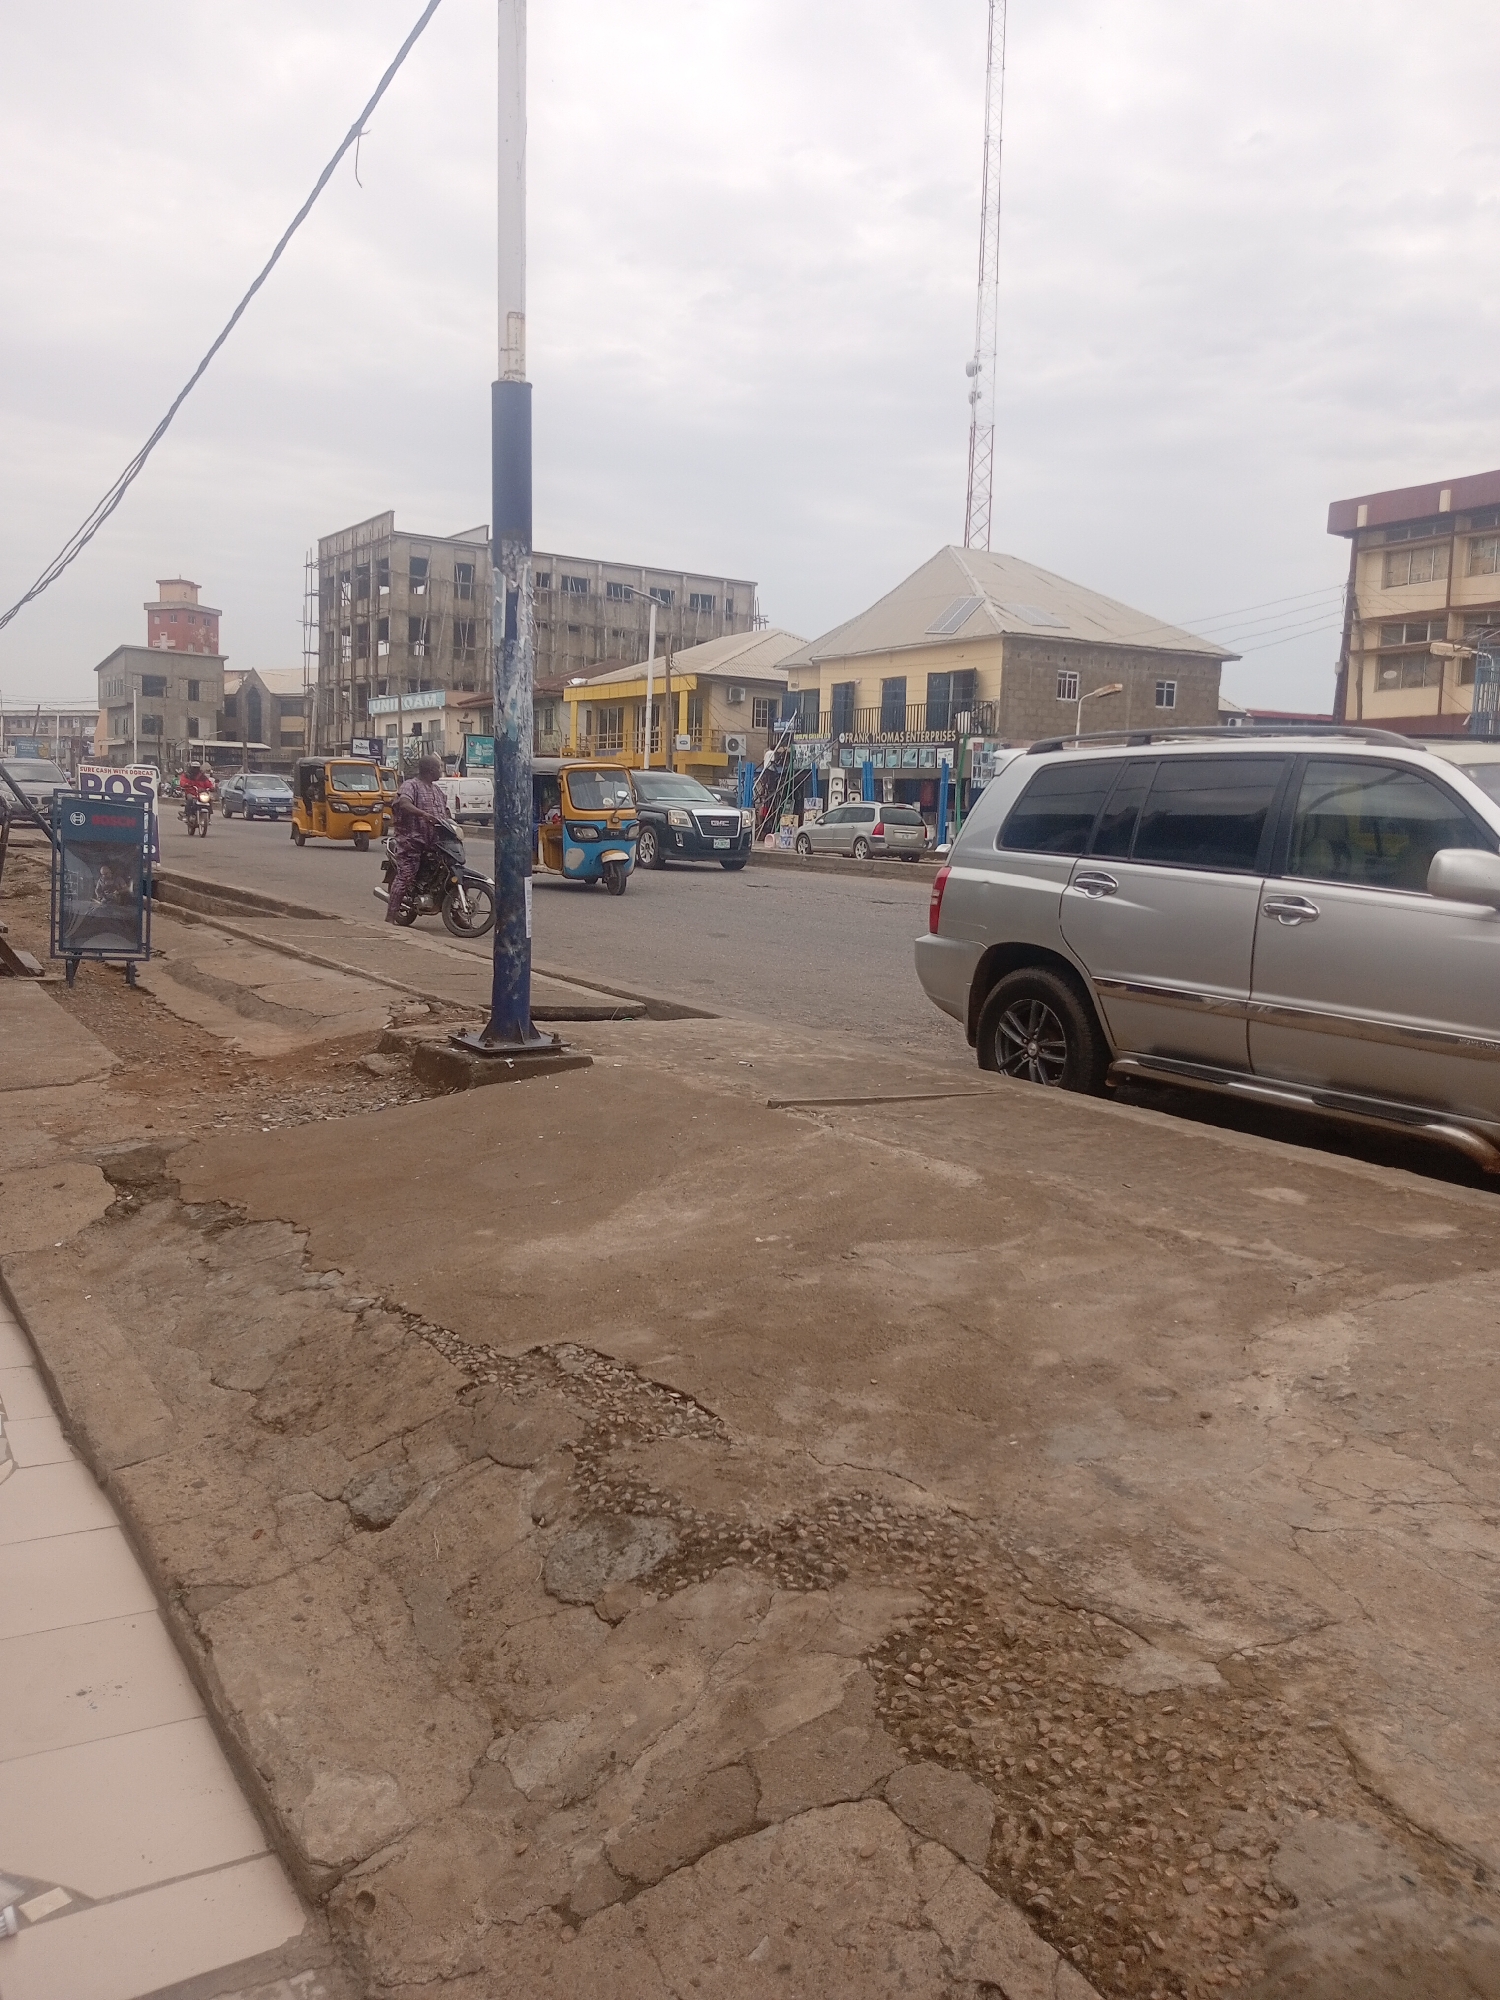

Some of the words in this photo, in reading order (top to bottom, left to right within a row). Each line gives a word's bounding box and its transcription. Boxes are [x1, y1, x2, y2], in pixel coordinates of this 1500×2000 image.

[845, 733, 870, 744] FRANK
[872, 732, 904, 743] THOMAS
[905, 730, 956, 742] ENTERPRISES
[80, 773, 155, 806] POS
